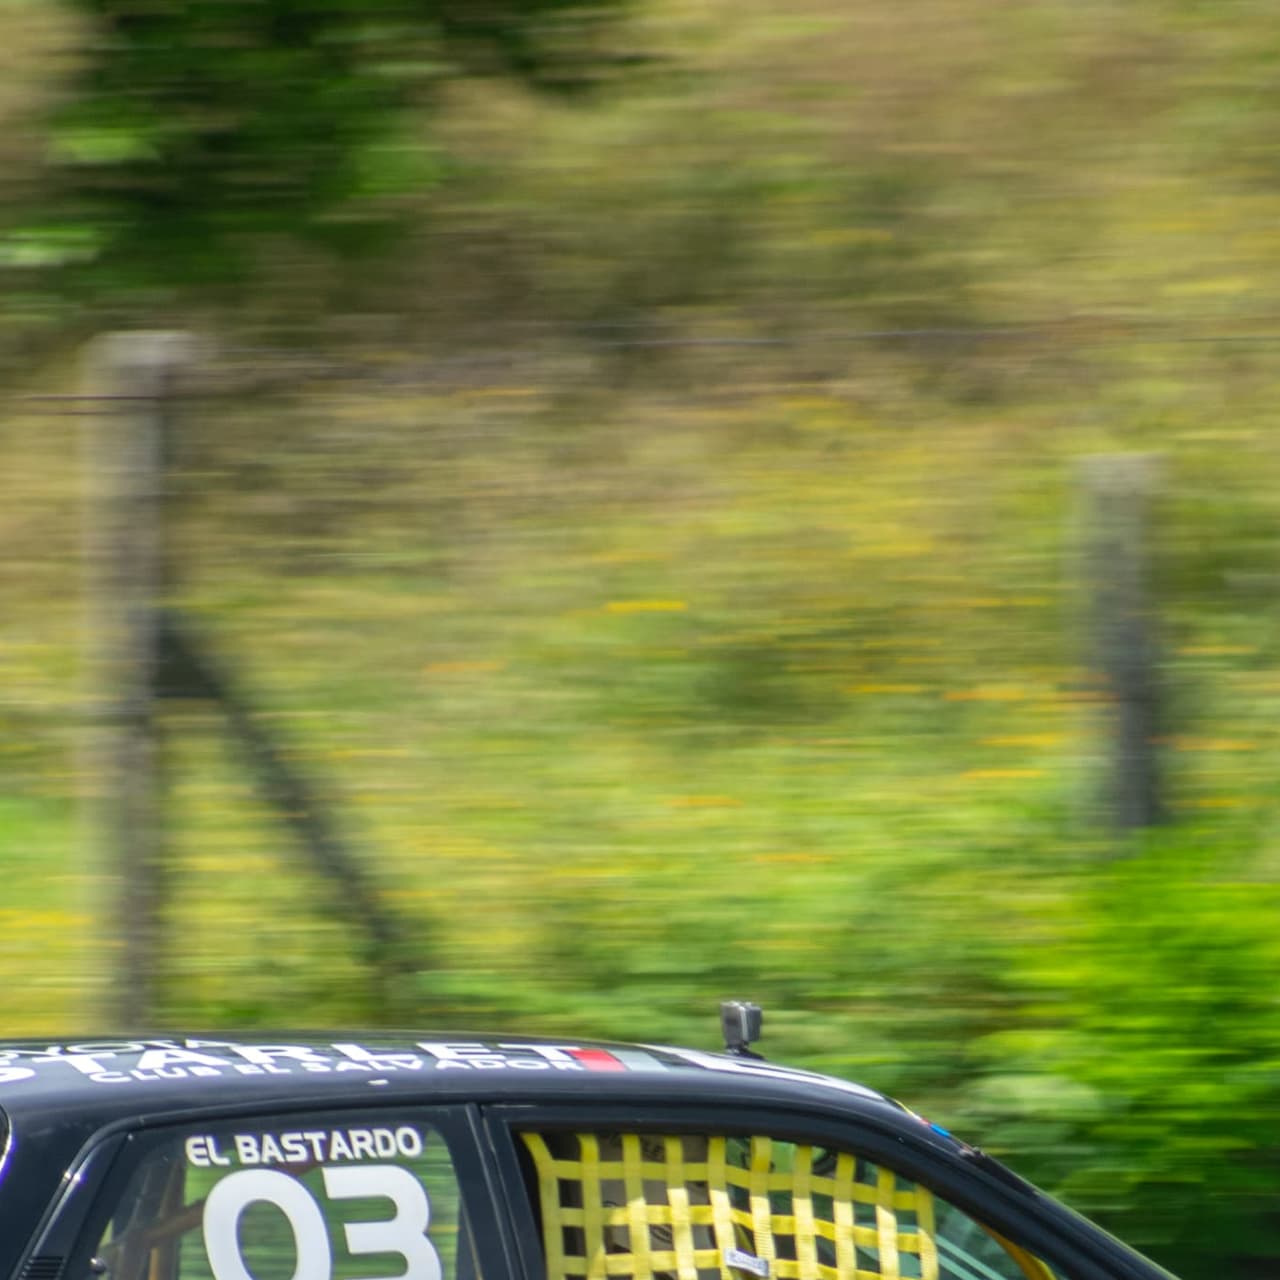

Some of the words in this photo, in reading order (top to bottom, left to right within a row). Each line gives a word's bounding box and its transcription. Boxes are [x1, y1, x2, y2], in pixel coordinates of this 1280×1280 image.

[89, 1064, 223, 1083] CLUB
[234, 1063, 293, 1075] EL
[300, 1060, 585, 1073] SALVADOR
[186, 1135, 231, 1166] EL
[235, 1126, 423, 1164] BASTARDO
